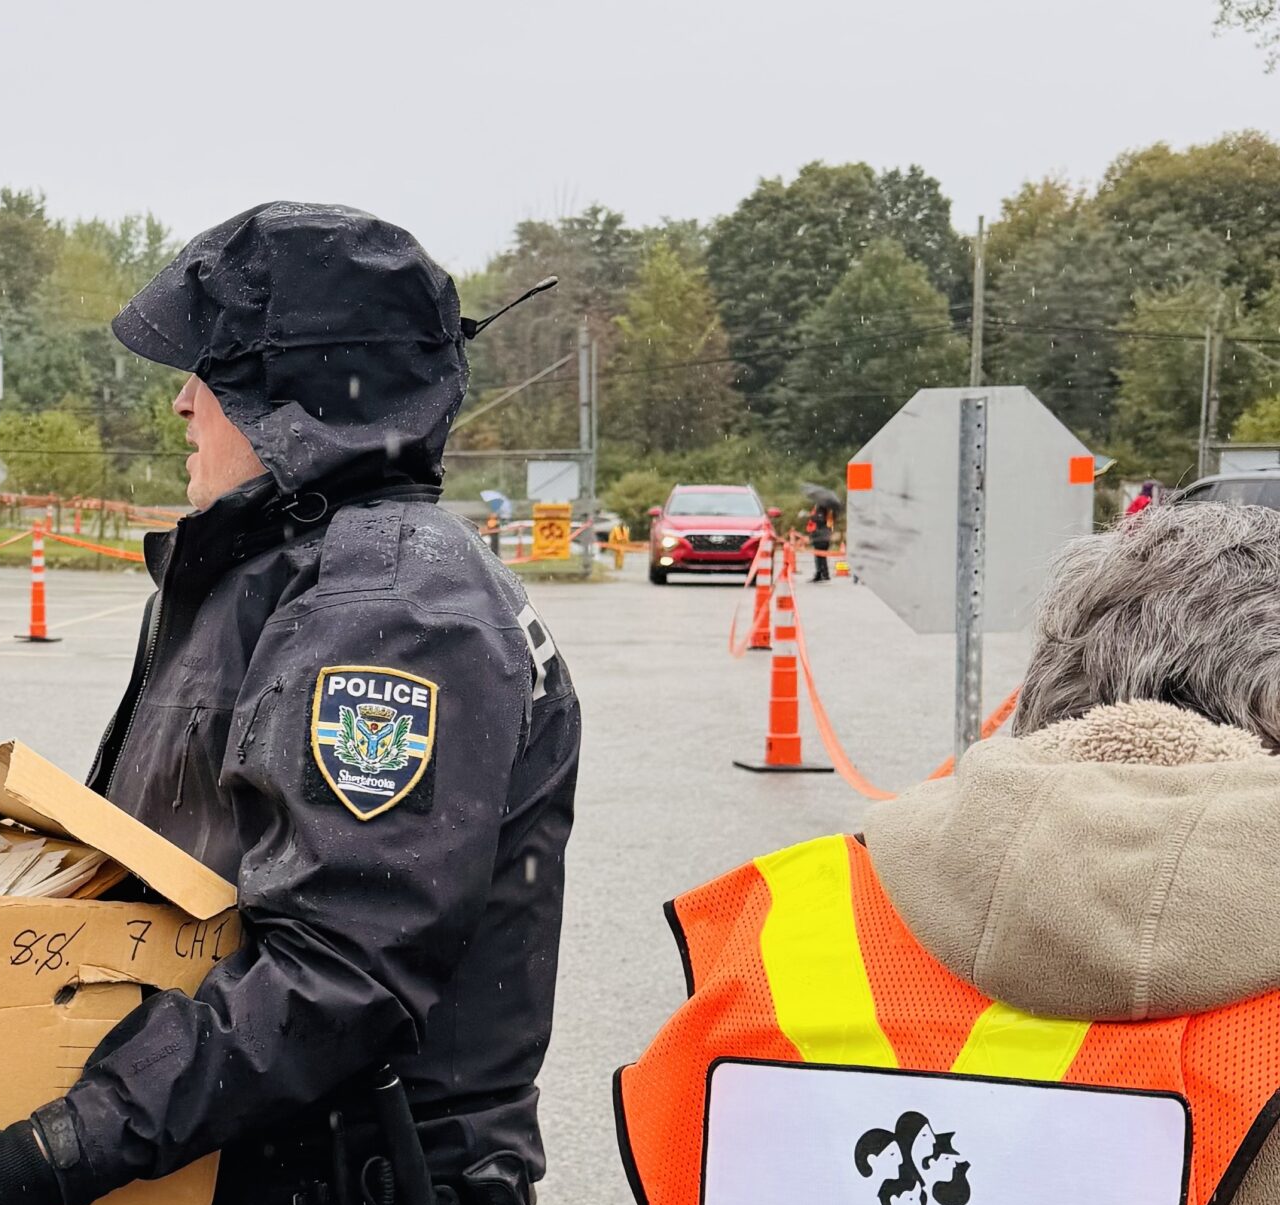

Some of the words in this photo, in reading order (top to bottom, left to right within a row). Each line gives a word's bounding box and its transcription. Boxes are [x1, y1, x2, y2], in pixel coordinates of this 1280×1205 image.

[327, 676, 428, 708] POLICE
[338, 769, 396, 789] Sherbrooke
[127, 919, 152, 961] 7
